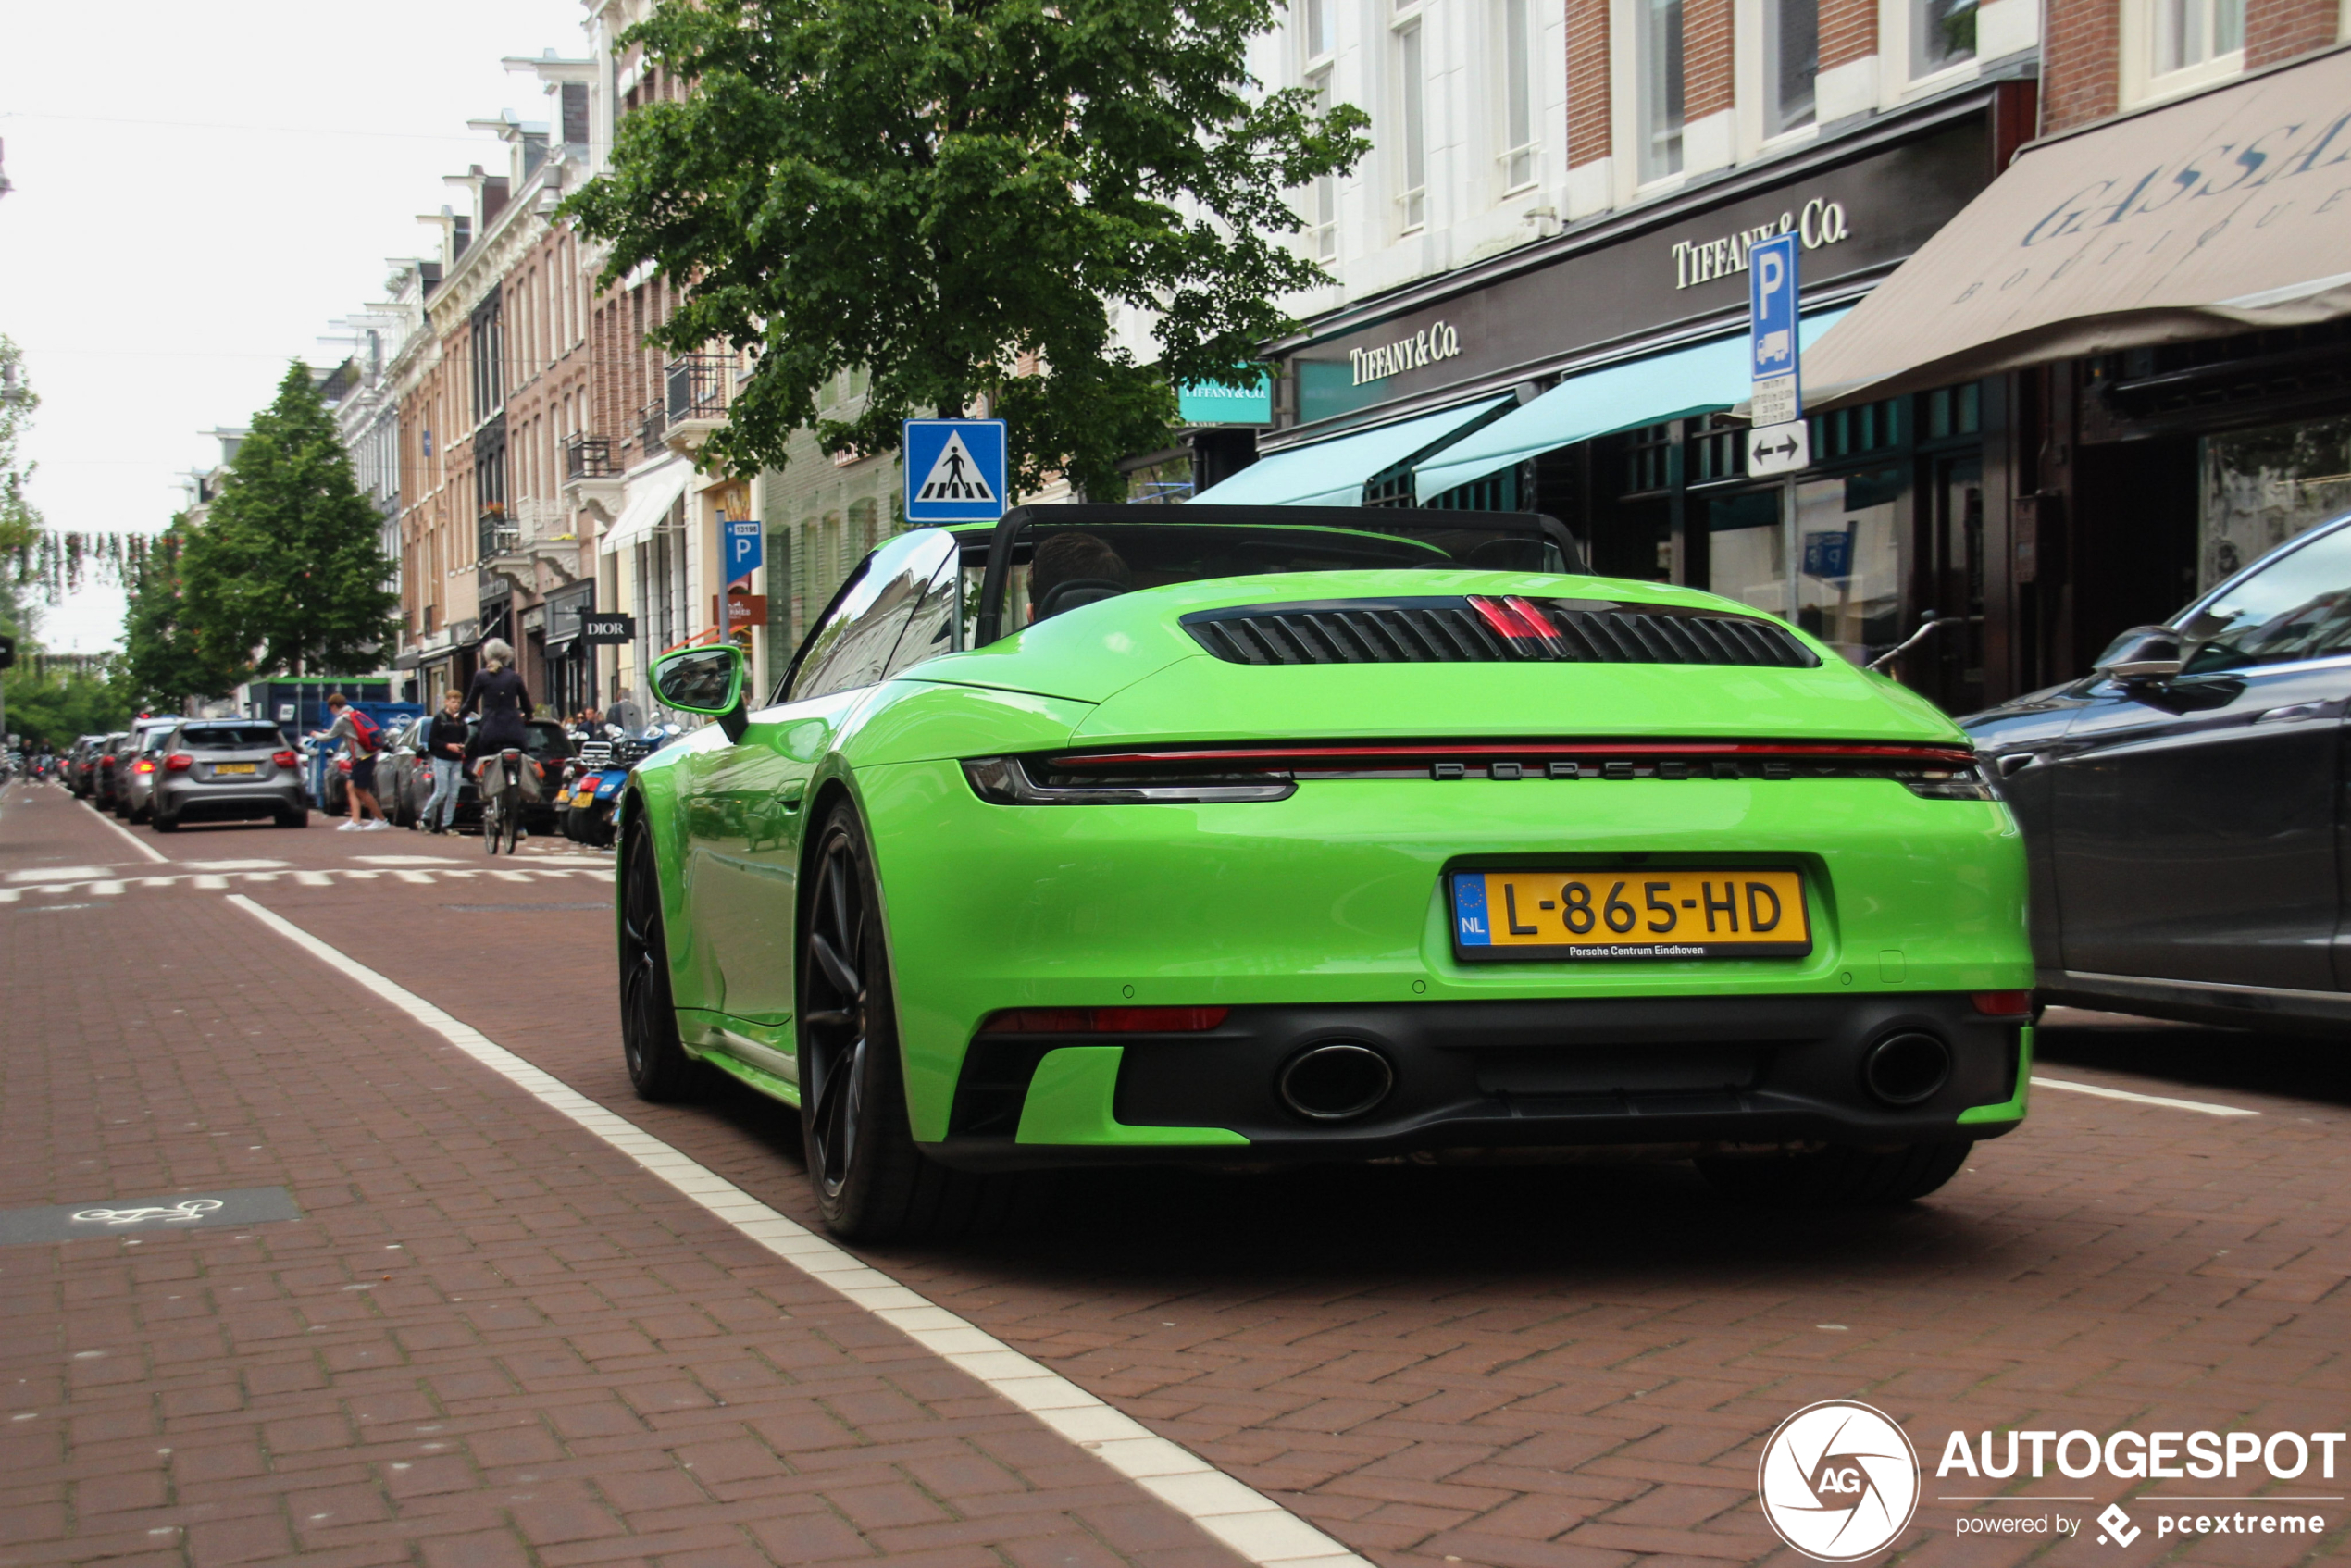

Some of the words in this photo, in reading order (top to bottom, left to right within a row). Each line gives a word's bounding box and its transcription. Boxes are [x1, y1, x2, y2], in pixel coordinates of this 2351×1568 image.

[2021, 108, 2351, 248] GASSA
[1951, 187, 2351, 305] BOUTIQUE
[1759, 251, 1784, 321] P
[736, 538, 752, 563] P
[587, 622, 625, 635] DIOR
[1430, 761, 1793, 781] PORSCHE
[1503, 881, 1782, 935] L-865-HD
[1461, 916, 1486, 934] NL
[1569, 945, 1609, 956] Porsche
[1611, 944, 1652, 956] Centrum
[1654, 944, 1704, 955] Eindhoven
